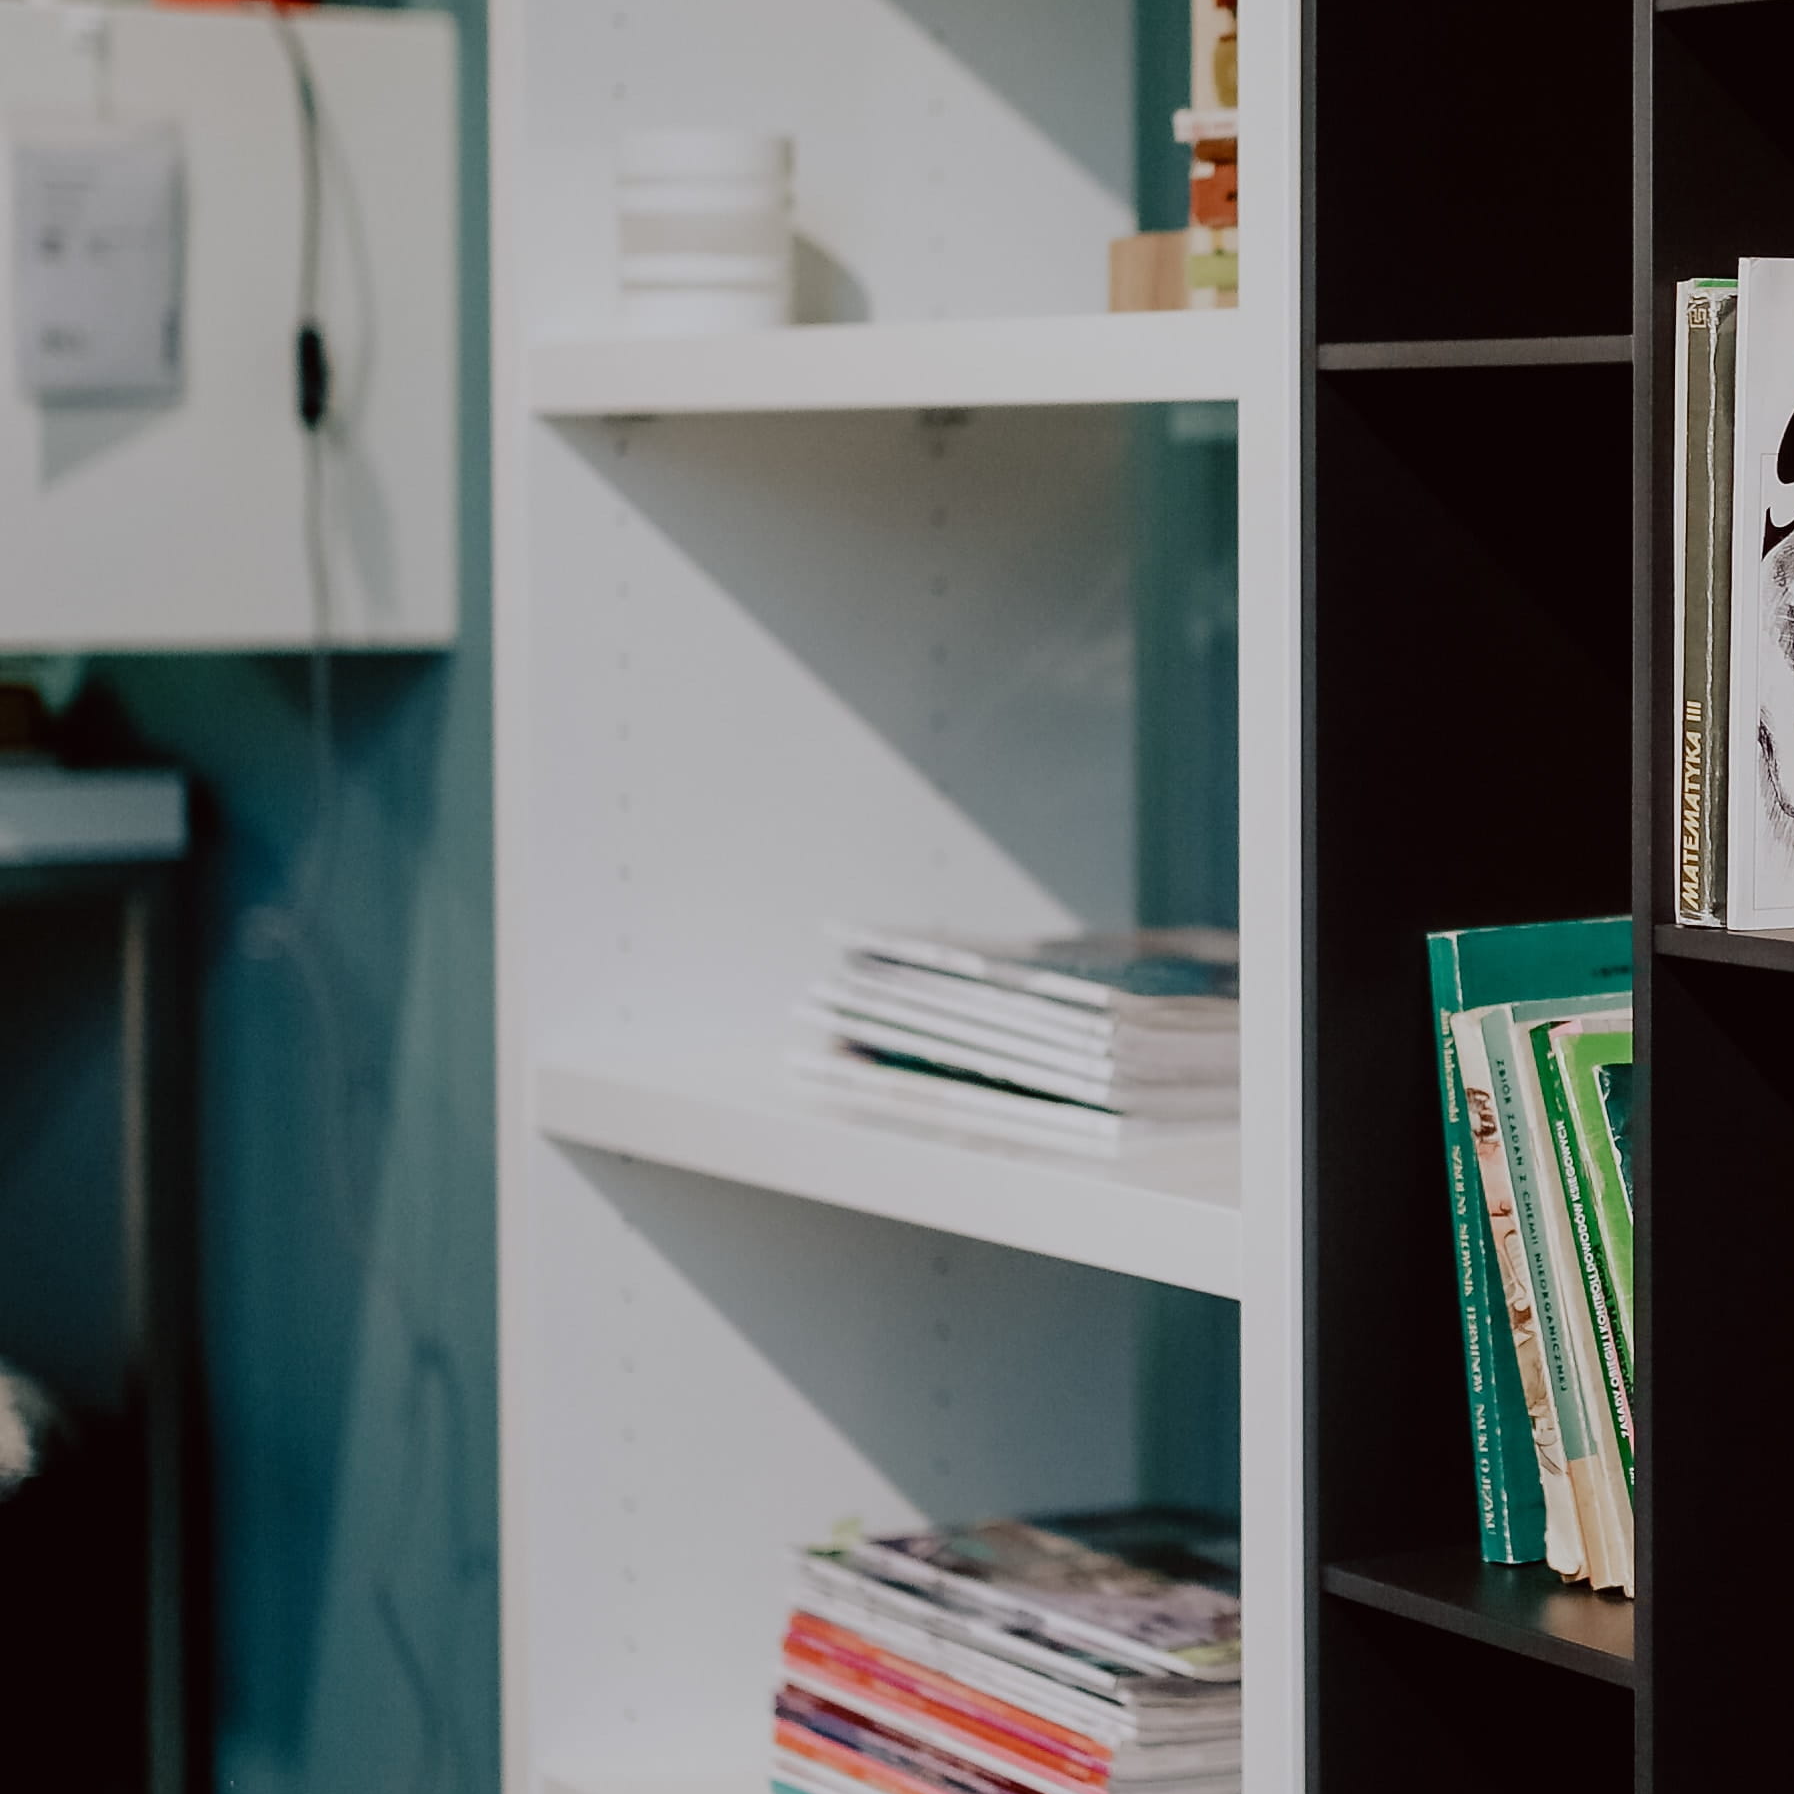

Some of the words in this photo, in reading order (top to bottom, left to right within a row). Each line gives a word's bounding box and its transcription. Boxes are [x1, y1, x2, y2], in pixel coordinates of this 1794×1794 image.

[1686, 700, 1702, 722] III
[1681, 730, 1702, 911] MATEMATYKA
[1612, 1389, 1630, 1439] ZASADY
